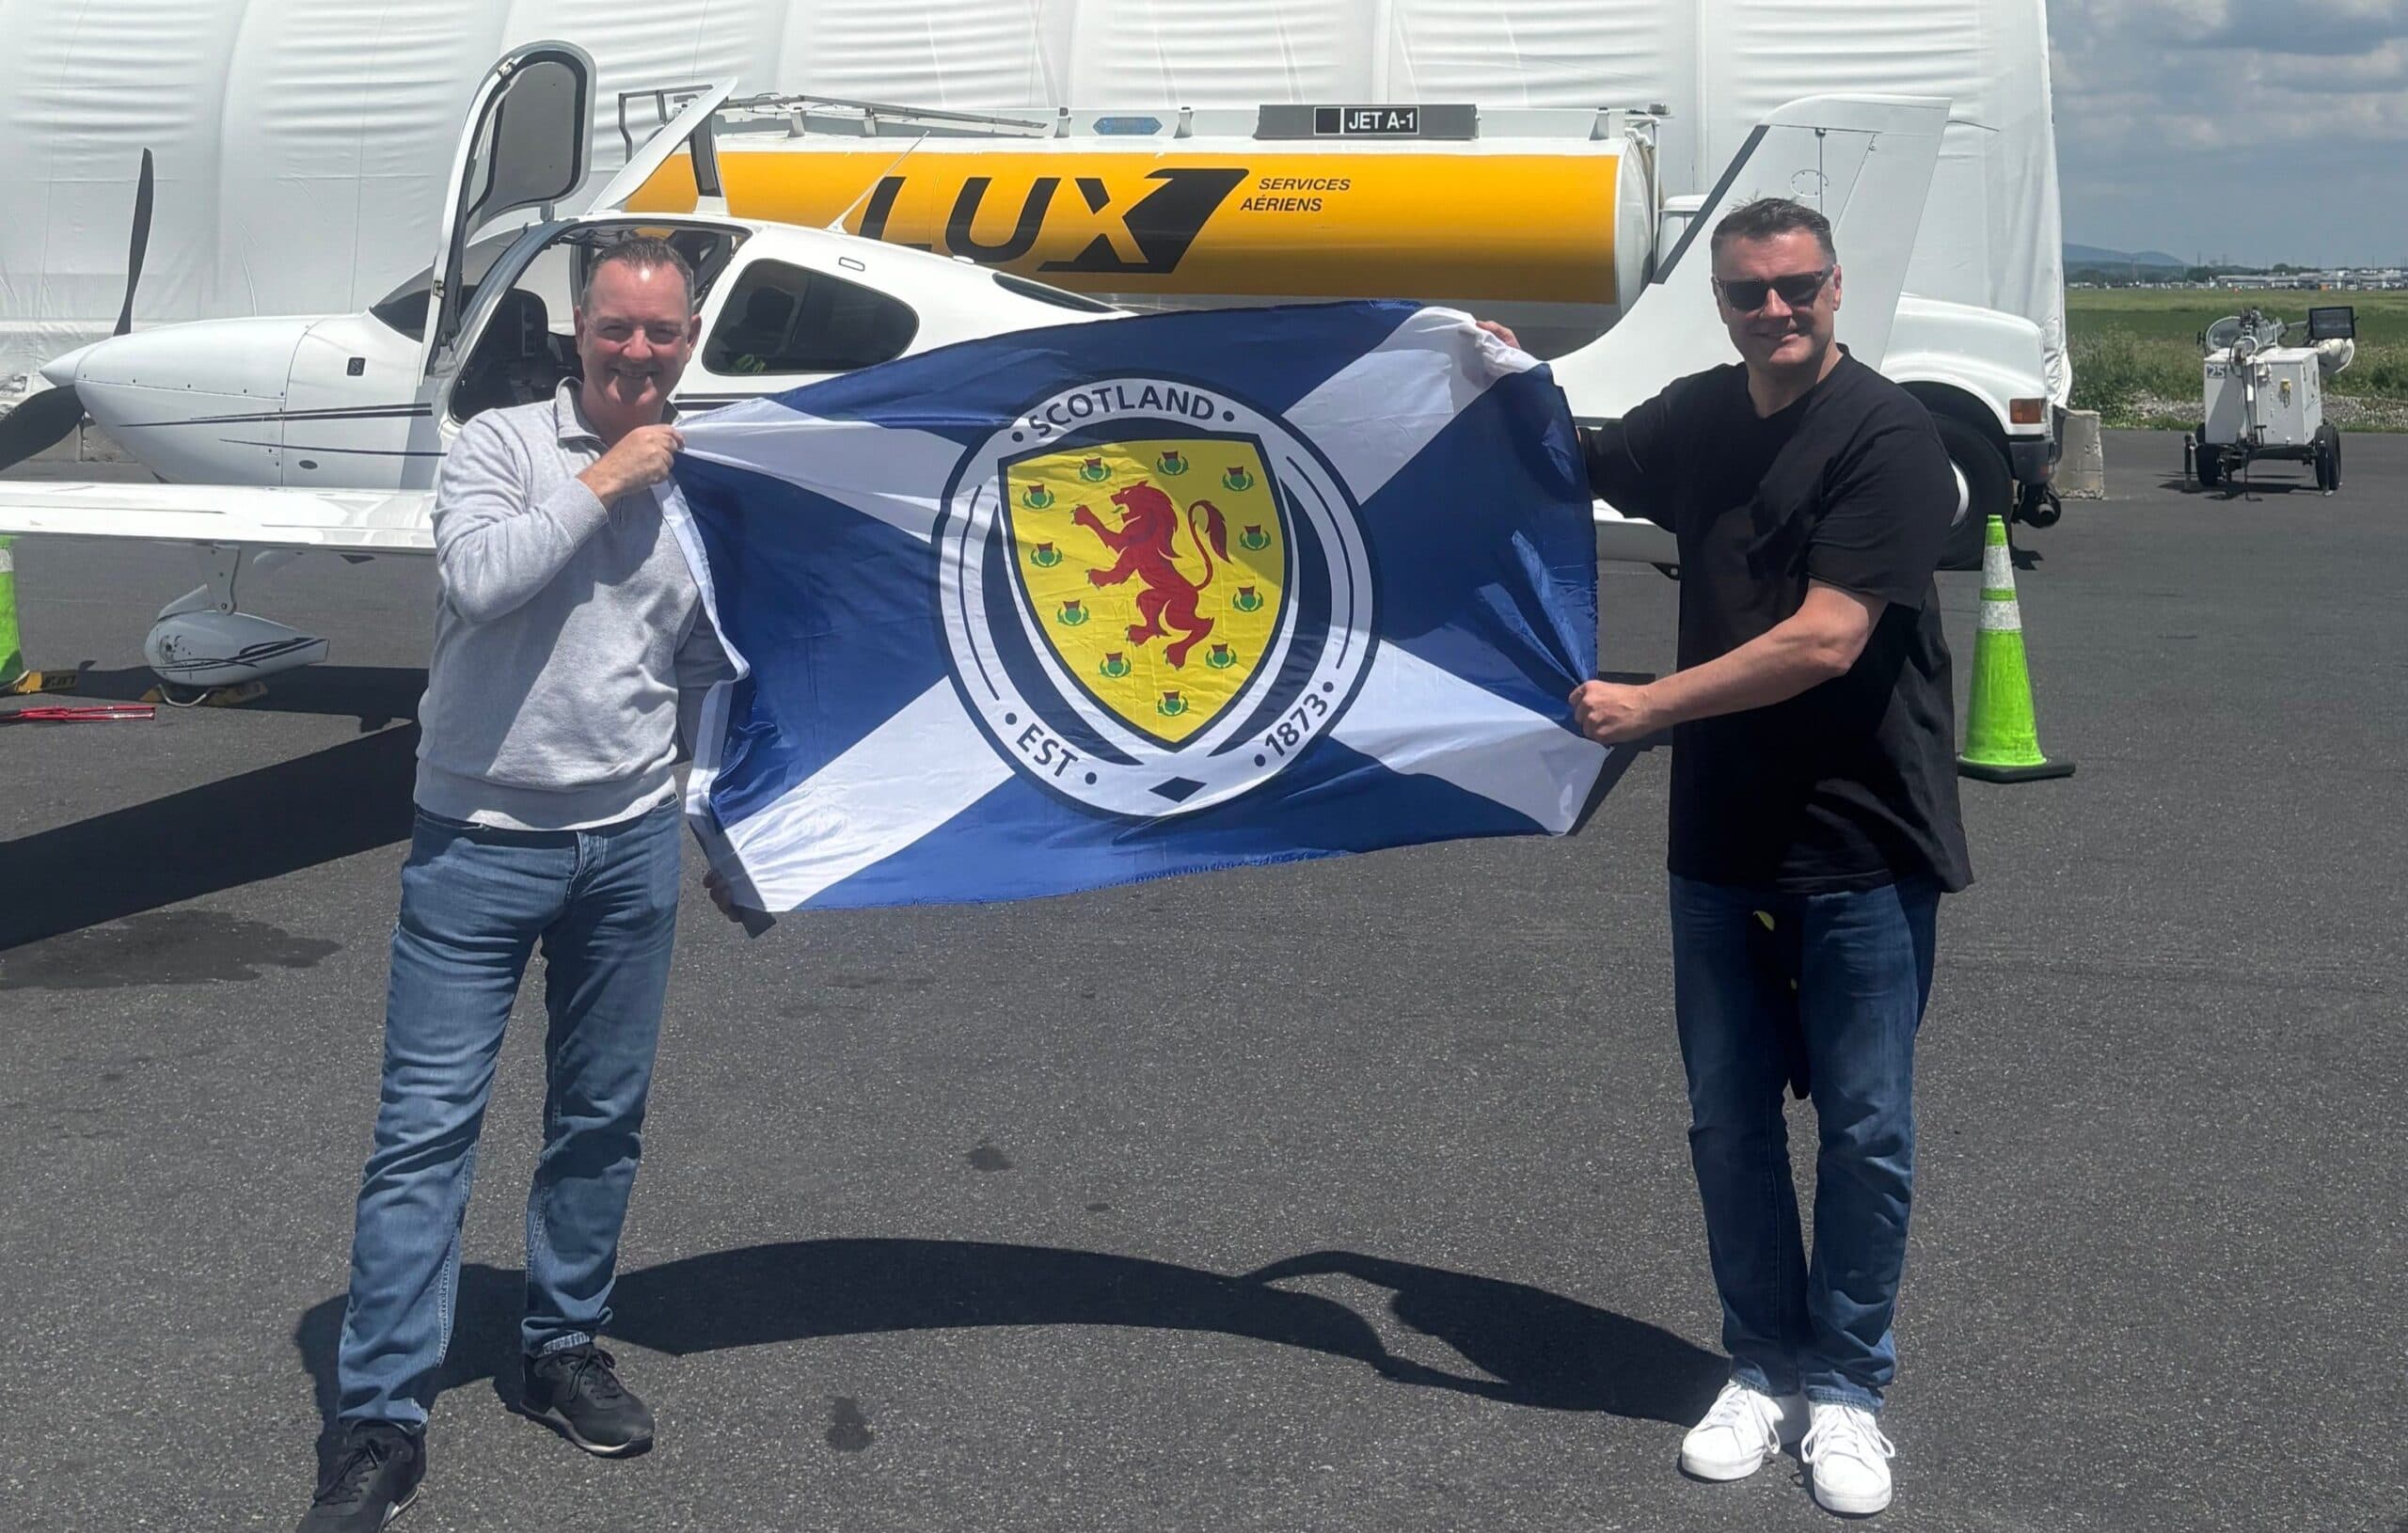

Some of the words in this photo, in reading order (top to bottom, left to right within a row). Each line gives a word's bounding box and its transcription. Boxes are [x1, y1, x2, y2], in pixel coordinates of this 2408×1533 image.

[1348, 112, 1383, 130] JET
[1386, 112, 1415, 130] A-1
[1239, 194, 1323, 212] AÉRIENS
[1258, 178, 1352, 191] SERVICES
[858, 167, 1250, 274] LUX
[1028, 384, 1214, 438] SCOTLAND
[1016, 722, 1079, 779] EST
[1264, 692, 1328, 758] 1873
